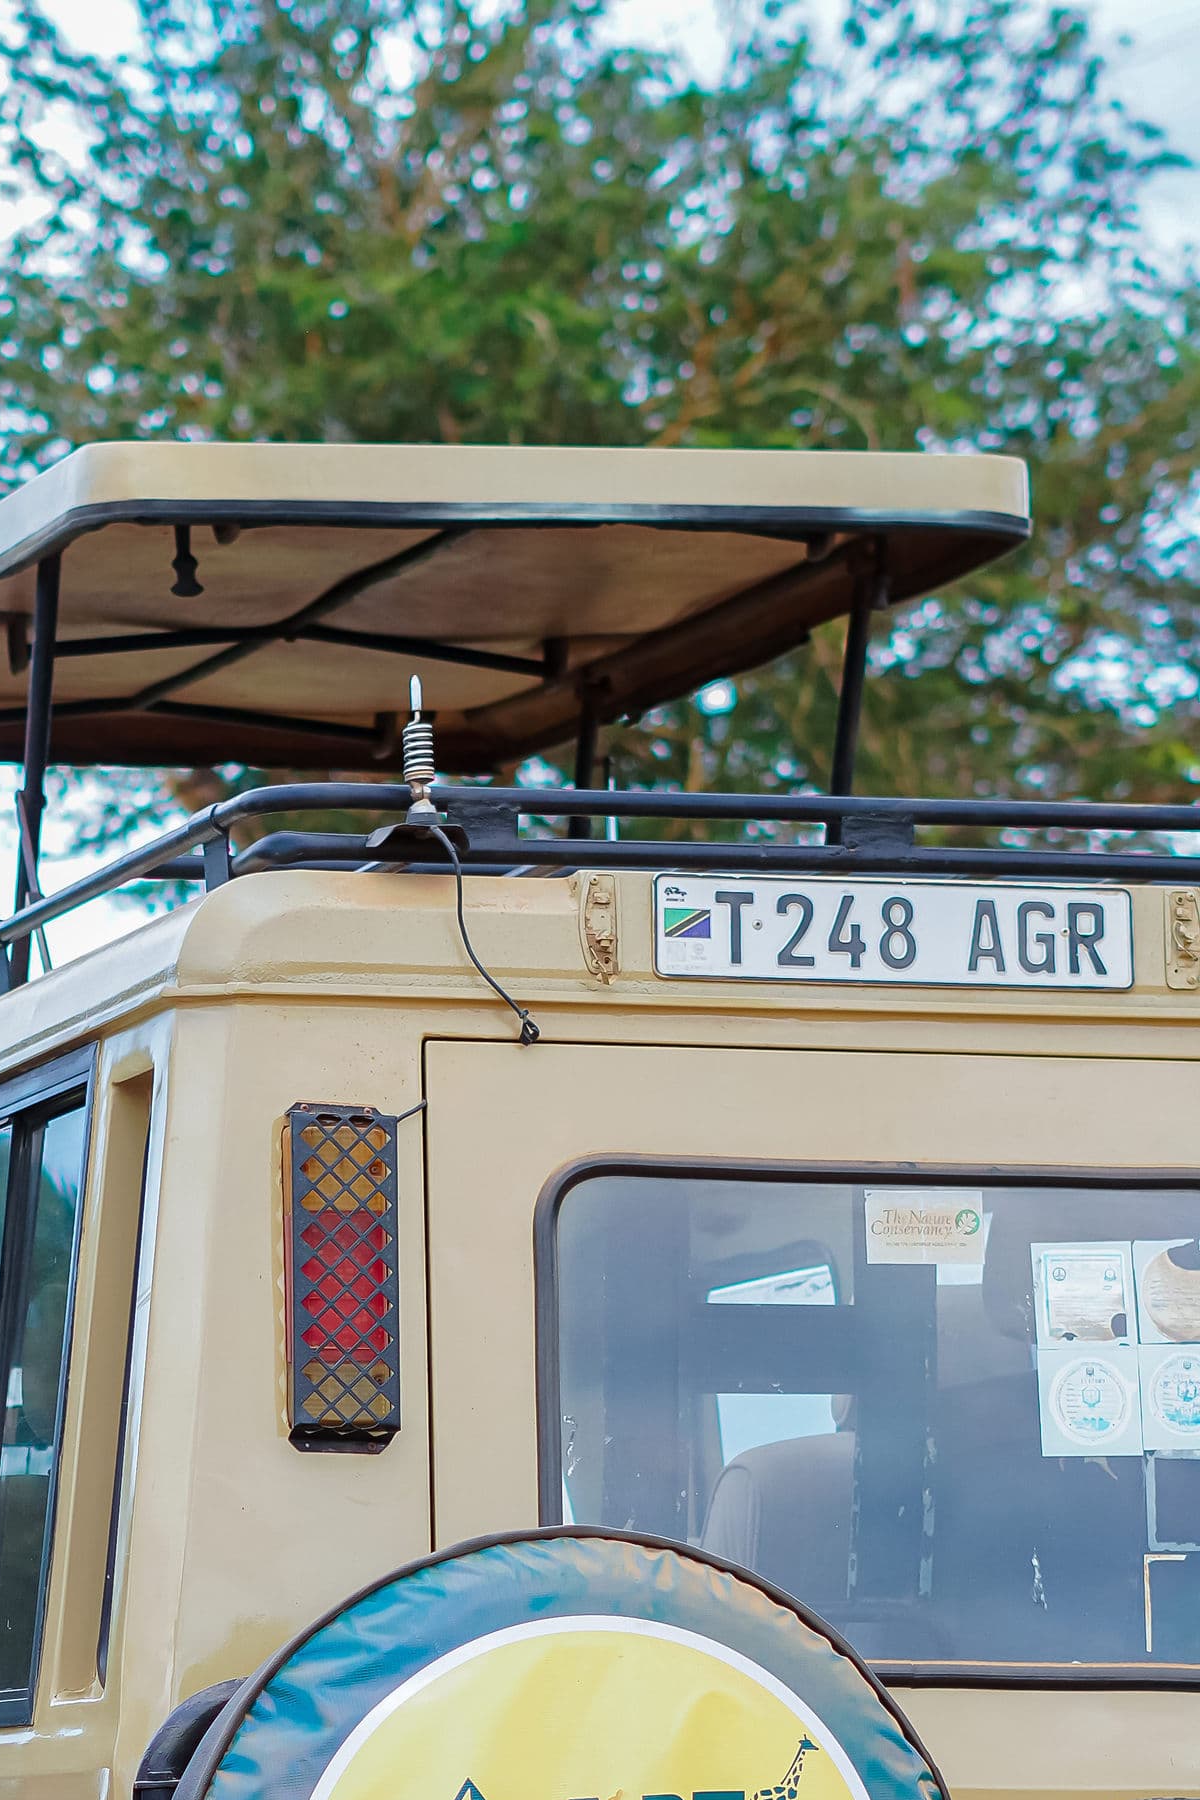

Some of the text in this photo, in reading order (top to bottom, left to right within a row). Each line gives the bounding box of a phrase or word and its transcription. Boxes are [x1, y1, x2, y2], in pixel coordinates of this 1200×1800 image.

[715, 891, 1108, 976] T 248 AGR
